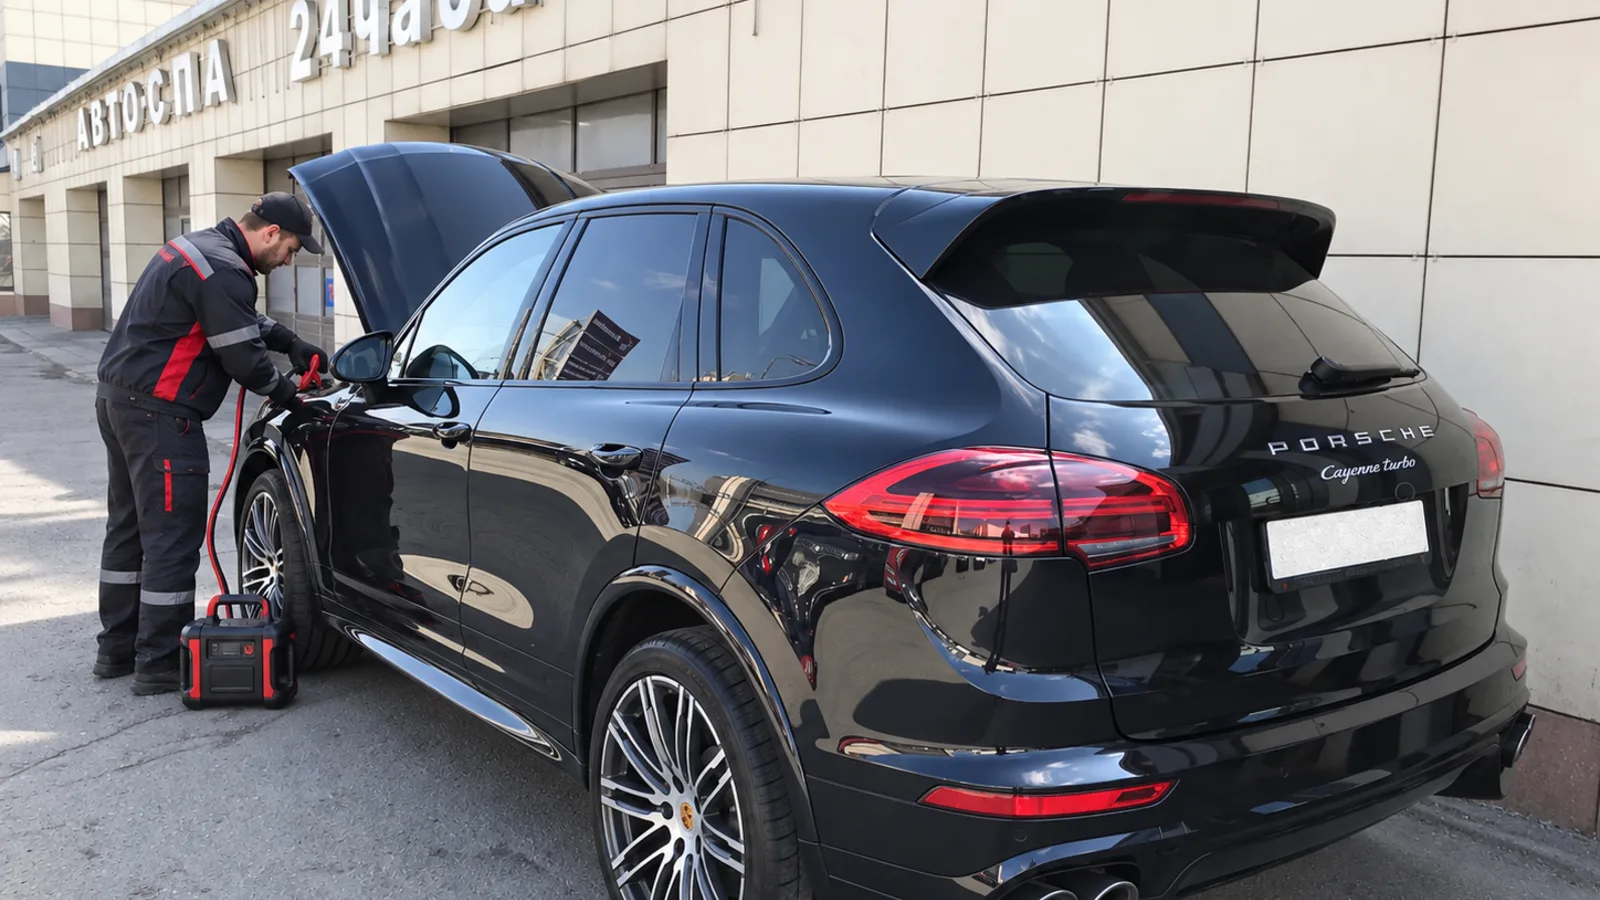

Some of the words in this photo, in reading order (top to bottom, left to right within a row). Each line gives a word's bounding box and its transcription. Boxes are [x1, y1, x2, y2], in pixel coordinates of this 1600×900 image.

[1267, 425, 1435, 456] PORSCHE
[1320, 463, 1380, 485] Cayenne
[1382, 455, 1417, 472] turbo
